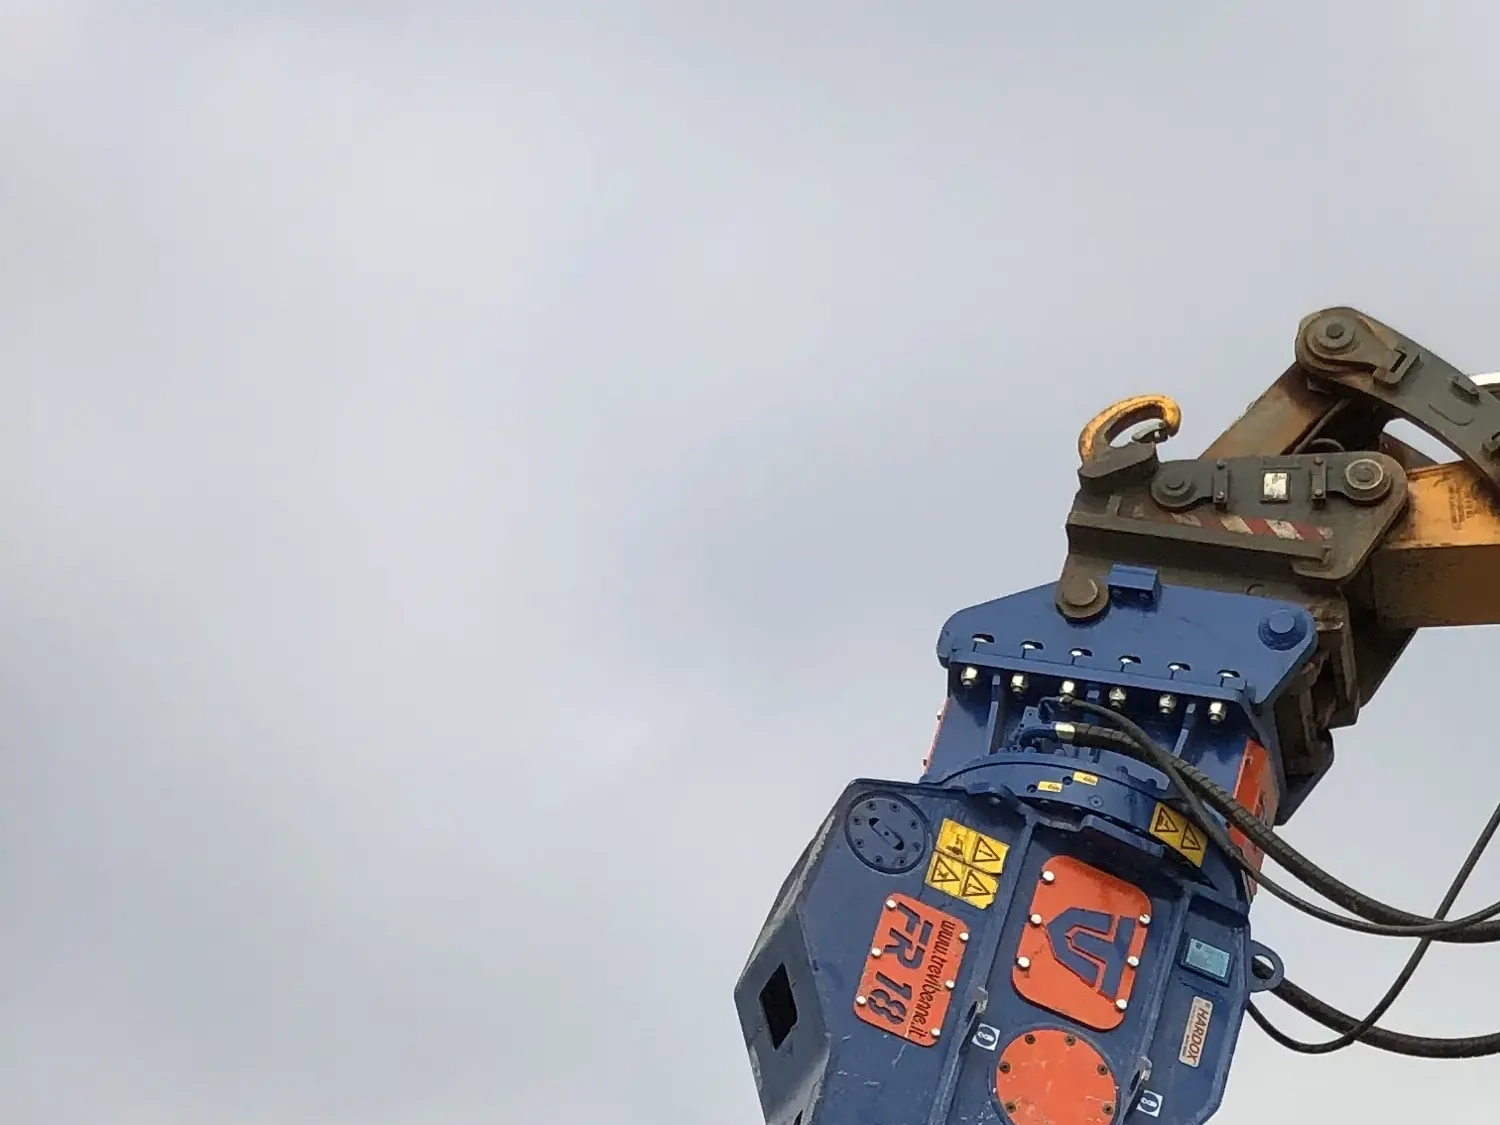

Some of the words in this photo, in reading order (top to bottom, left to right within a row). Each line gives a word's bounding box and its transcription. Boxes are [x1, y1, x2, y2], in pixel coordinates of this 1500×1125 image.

[882, 902, 934, 970] FR
[868, 971, 913, 1025] 18
[909, 920, 956, 1038] www.trevibenne.it
[1188, 1007, 1209, 1064] HARDOX
